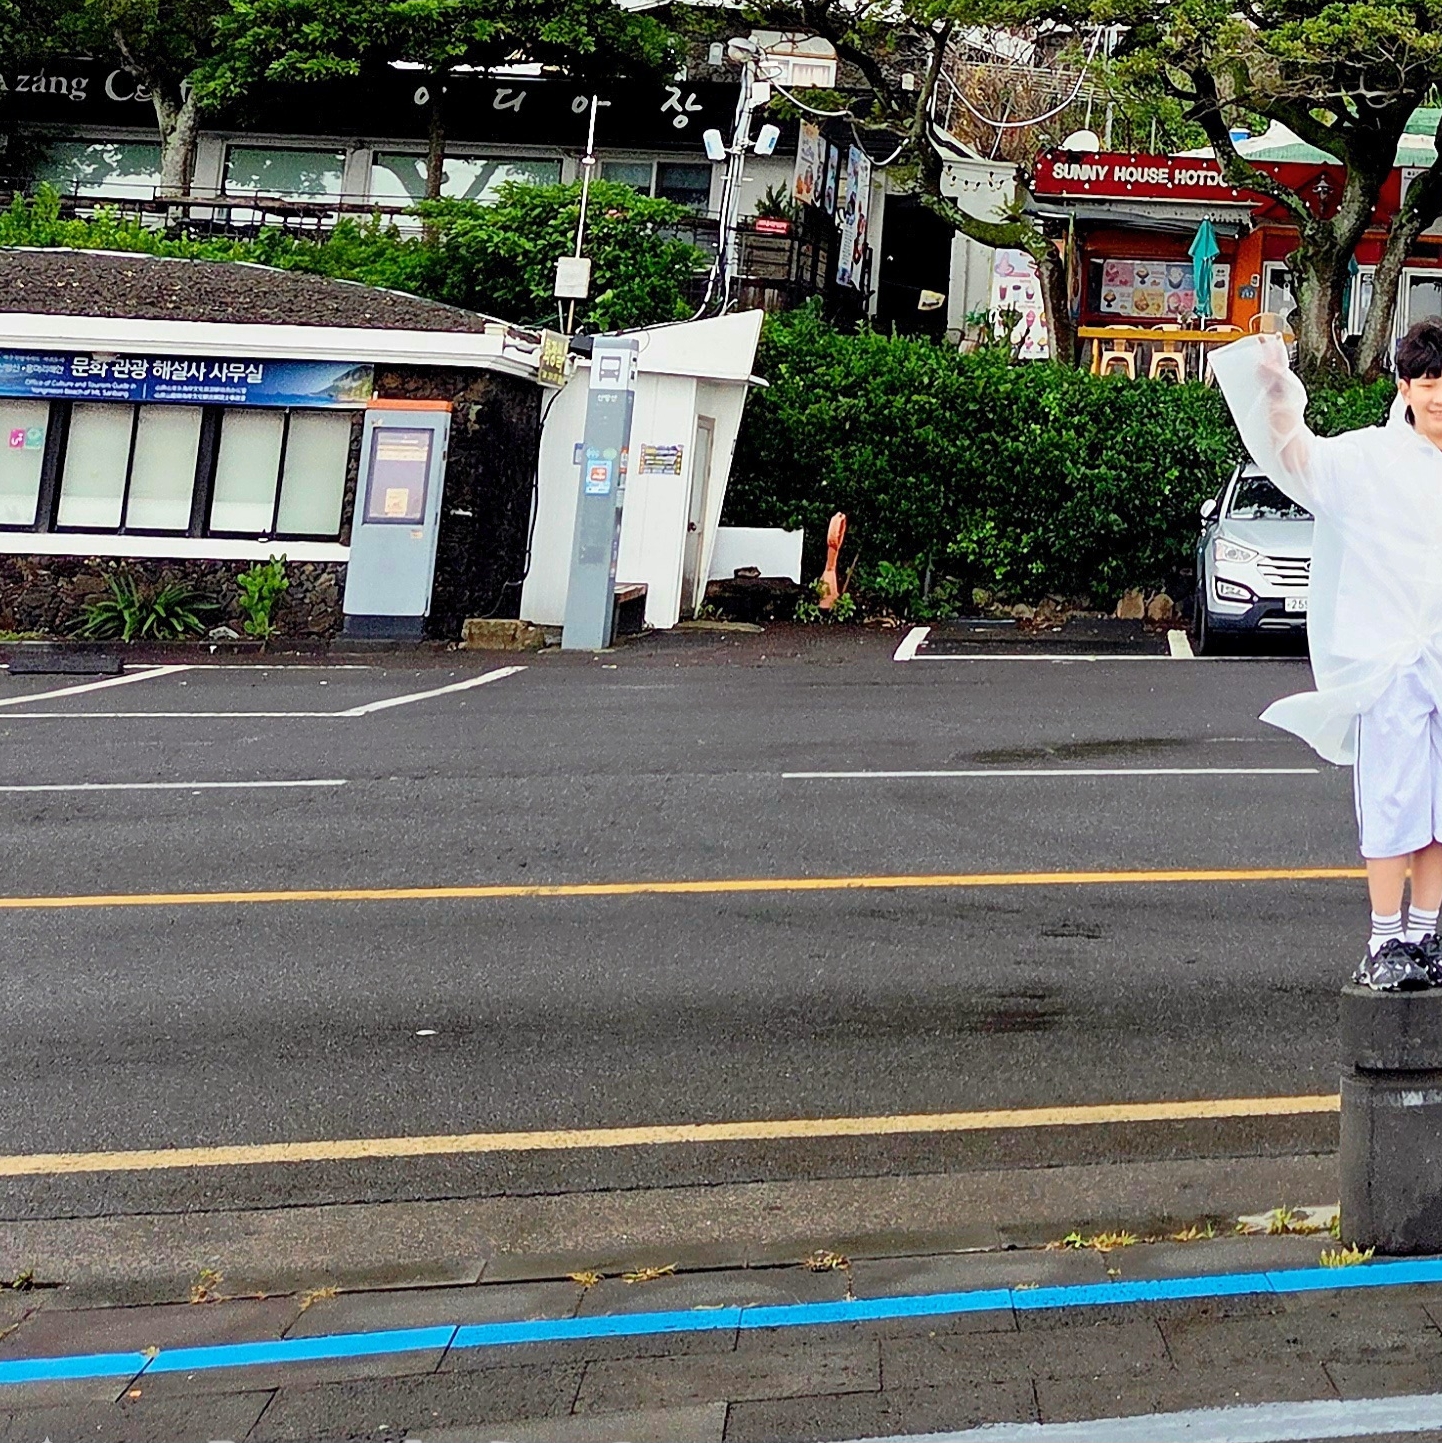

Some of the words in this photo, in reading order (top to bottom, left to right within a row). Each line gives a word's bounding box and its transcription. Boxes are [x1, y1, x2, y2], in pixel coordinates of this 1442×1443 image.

[1052, 162, 1109, 181] SUNNY
[1114, 165, 1169, 184] HOUSE
[71, 356, 108, 378] 문화
[111, 359, 149, 380] 관광
[152, 360, 207, 382] 해설사
[209, 363, 264, 384] 사무실
